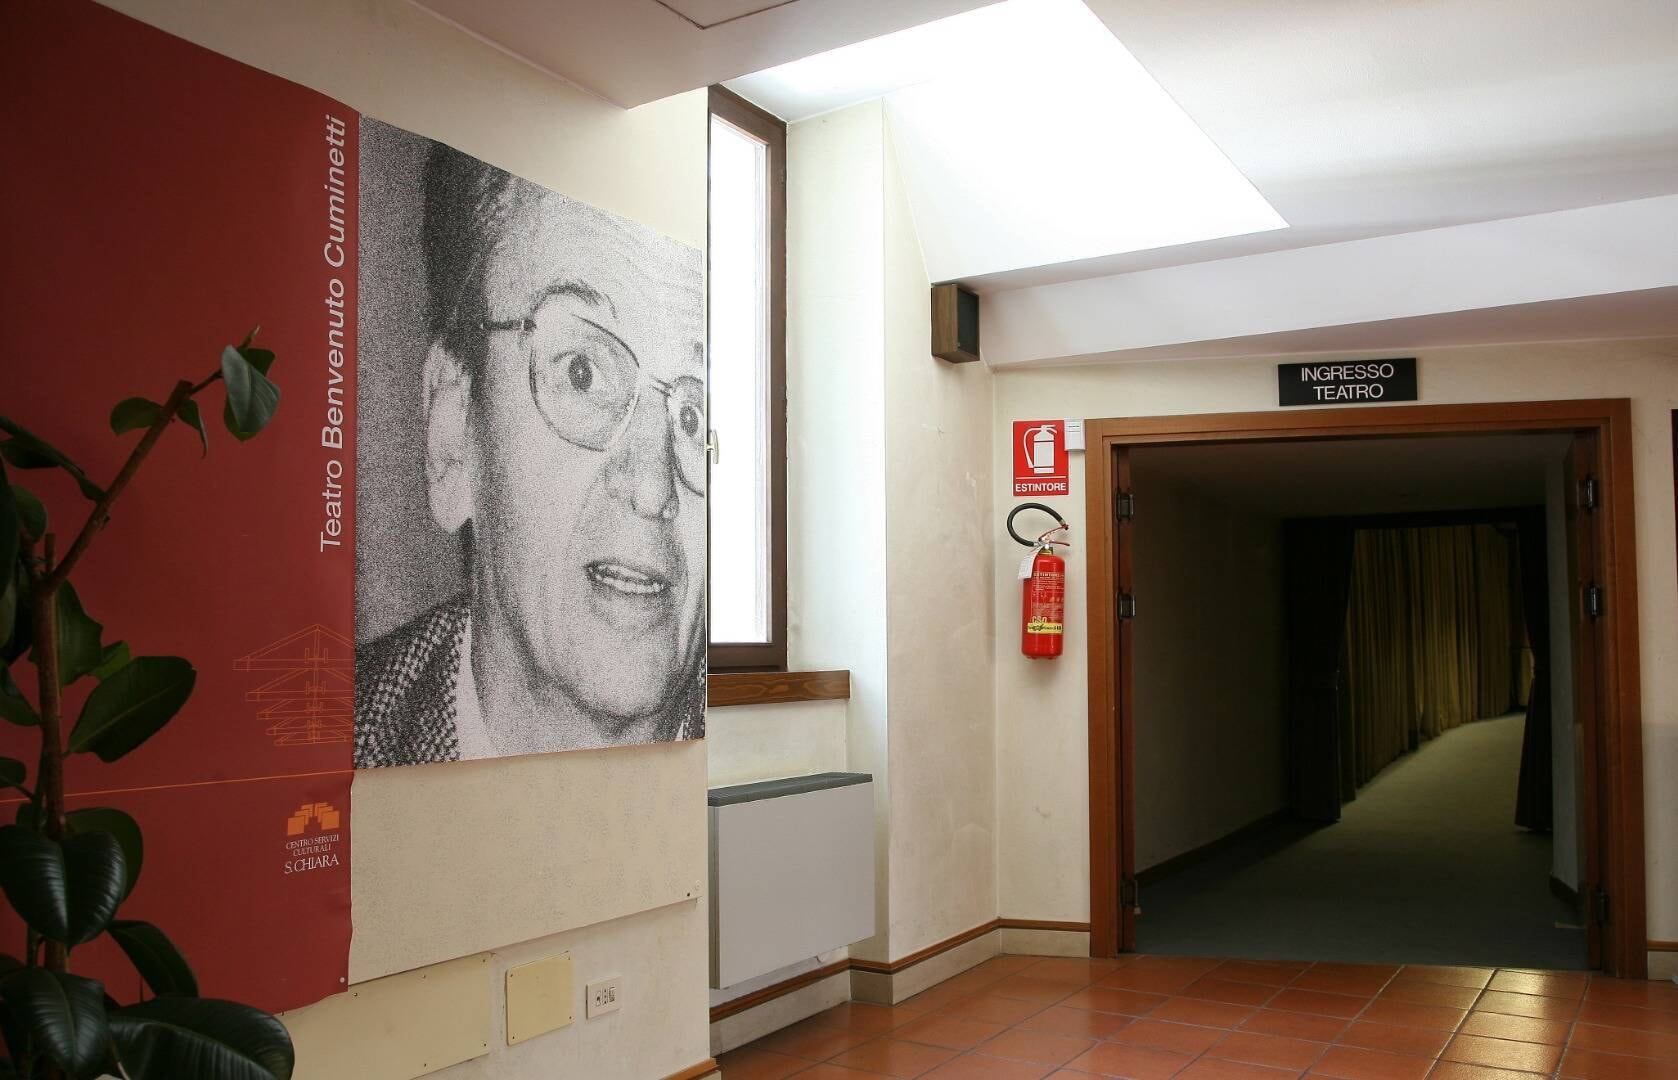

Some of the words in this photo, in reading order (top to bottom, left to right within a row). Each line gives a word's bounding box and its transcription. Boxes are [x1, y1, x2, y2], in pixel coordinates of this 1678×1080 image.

[323, 114, 346, 268] Cuminetti
[321, 278, 345, 450] Benvenuto
[1300, 363, 1395, 382] INGRESSO
[1312, 383, 1384, 401] TEATRO
[1015, 482, 1067, 492] ESTINTORE
[320, 459, 343, 552] Teatro
[285, 839, 314, 850] CENTRO
[314, 834, 339, 844] SERVIZI
[292, 843, 331, 857] CULTURALI
[294, 854, 340, 872] CHIARA
